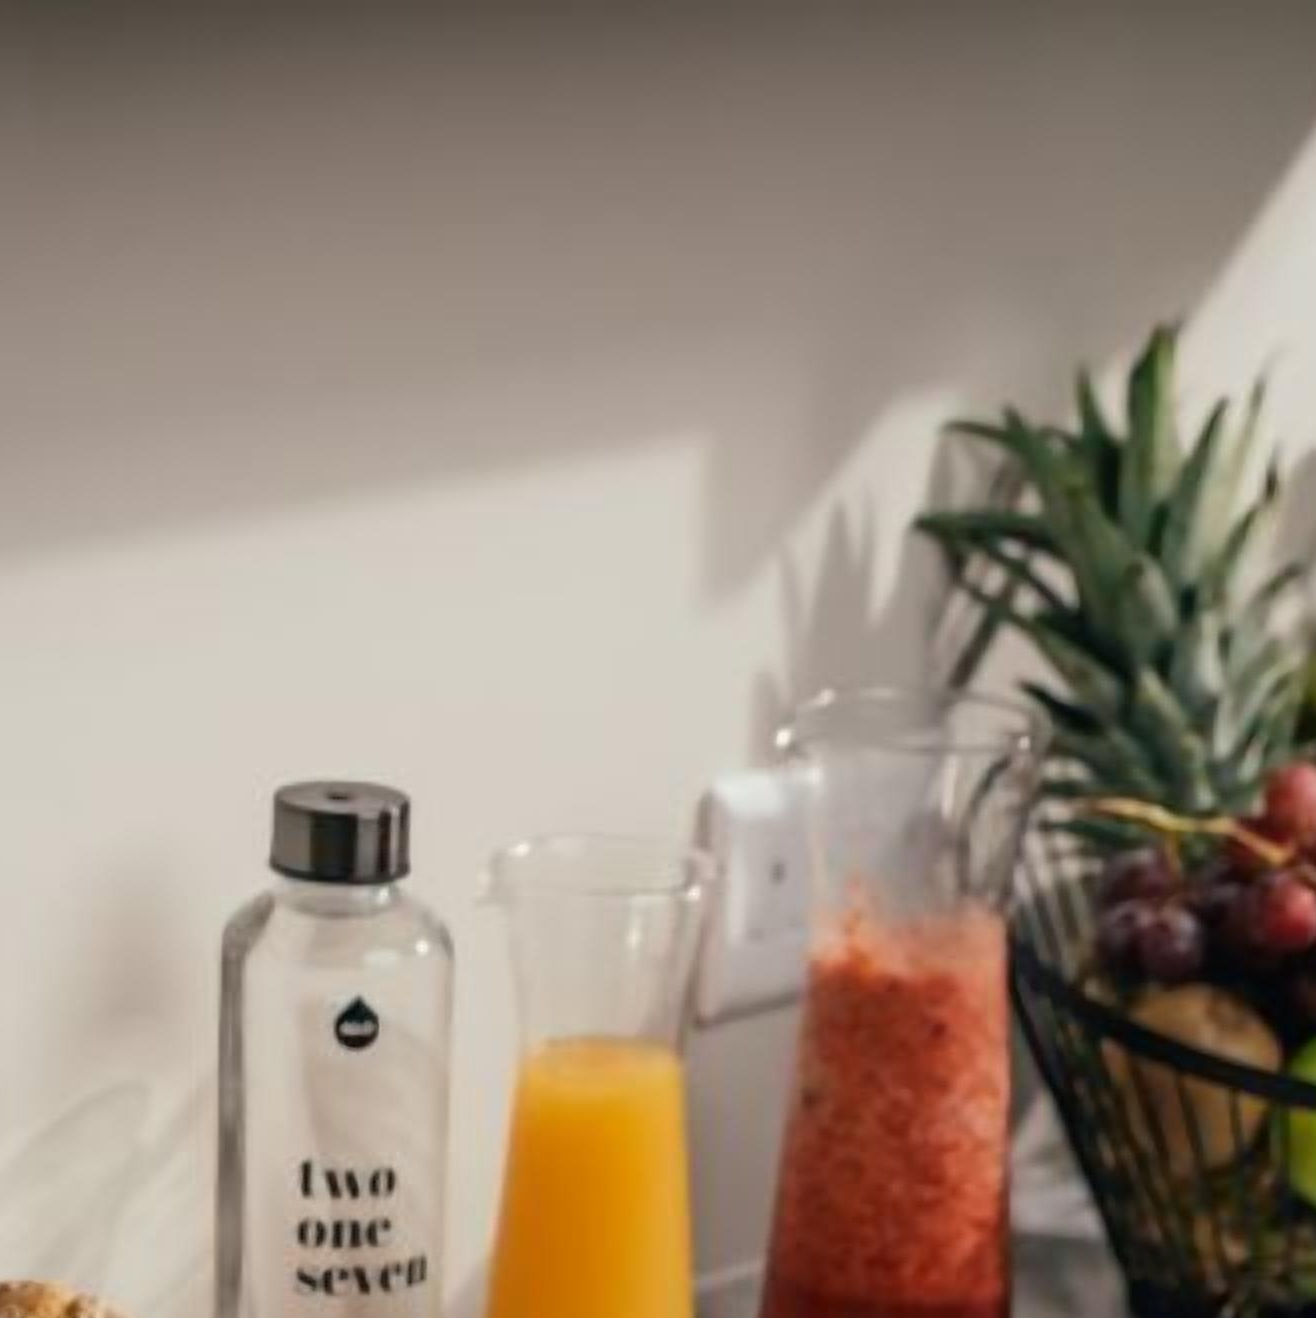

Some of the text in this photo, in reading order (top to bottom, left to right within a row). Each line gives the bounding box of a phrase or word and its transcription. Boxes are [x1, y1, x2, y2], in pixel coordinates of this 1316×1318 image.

[299, 1159, 396, 1198] two
[297, 1217, 393, 1248] one
[295, 1254, 428, 1295] seven
